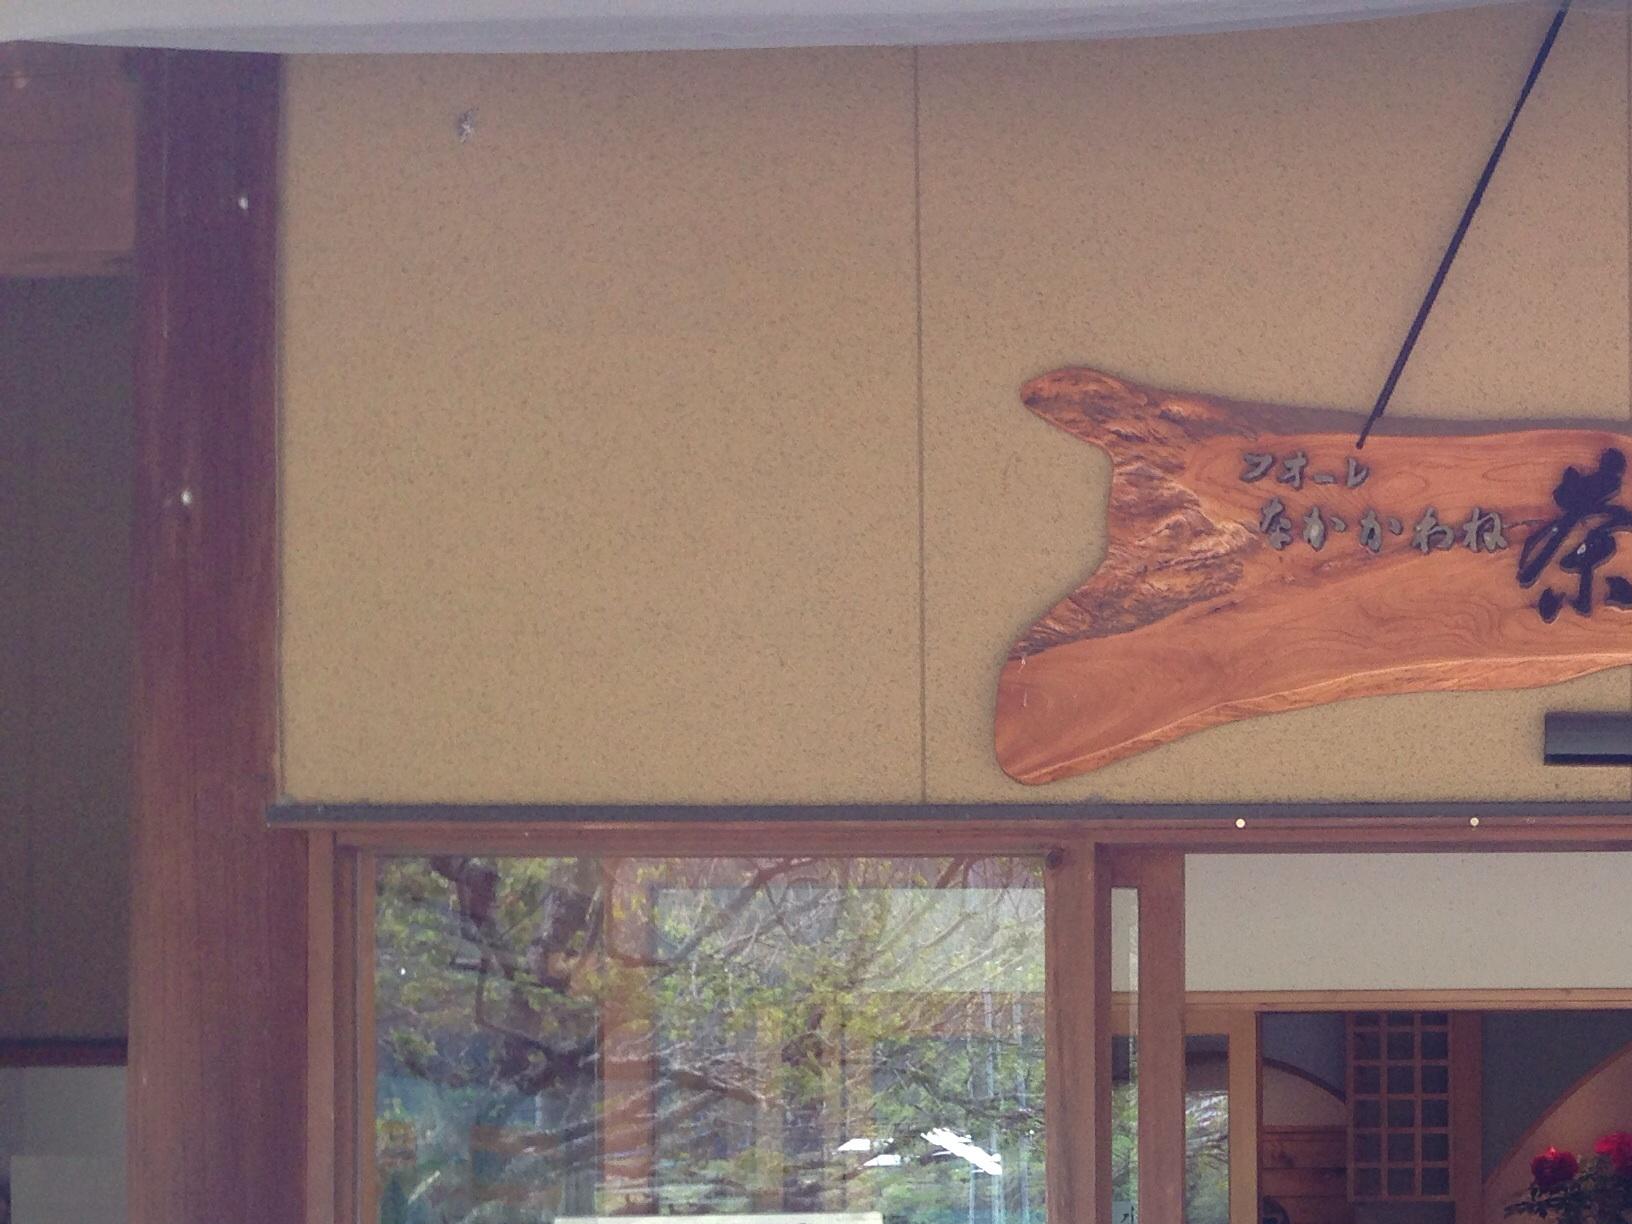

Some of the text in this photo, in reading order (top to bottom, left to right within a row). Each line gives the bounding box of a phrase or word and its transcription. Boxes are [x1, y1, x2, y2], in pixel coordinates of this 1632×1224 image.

[1260, 497, 1509, 554] なかかわね
